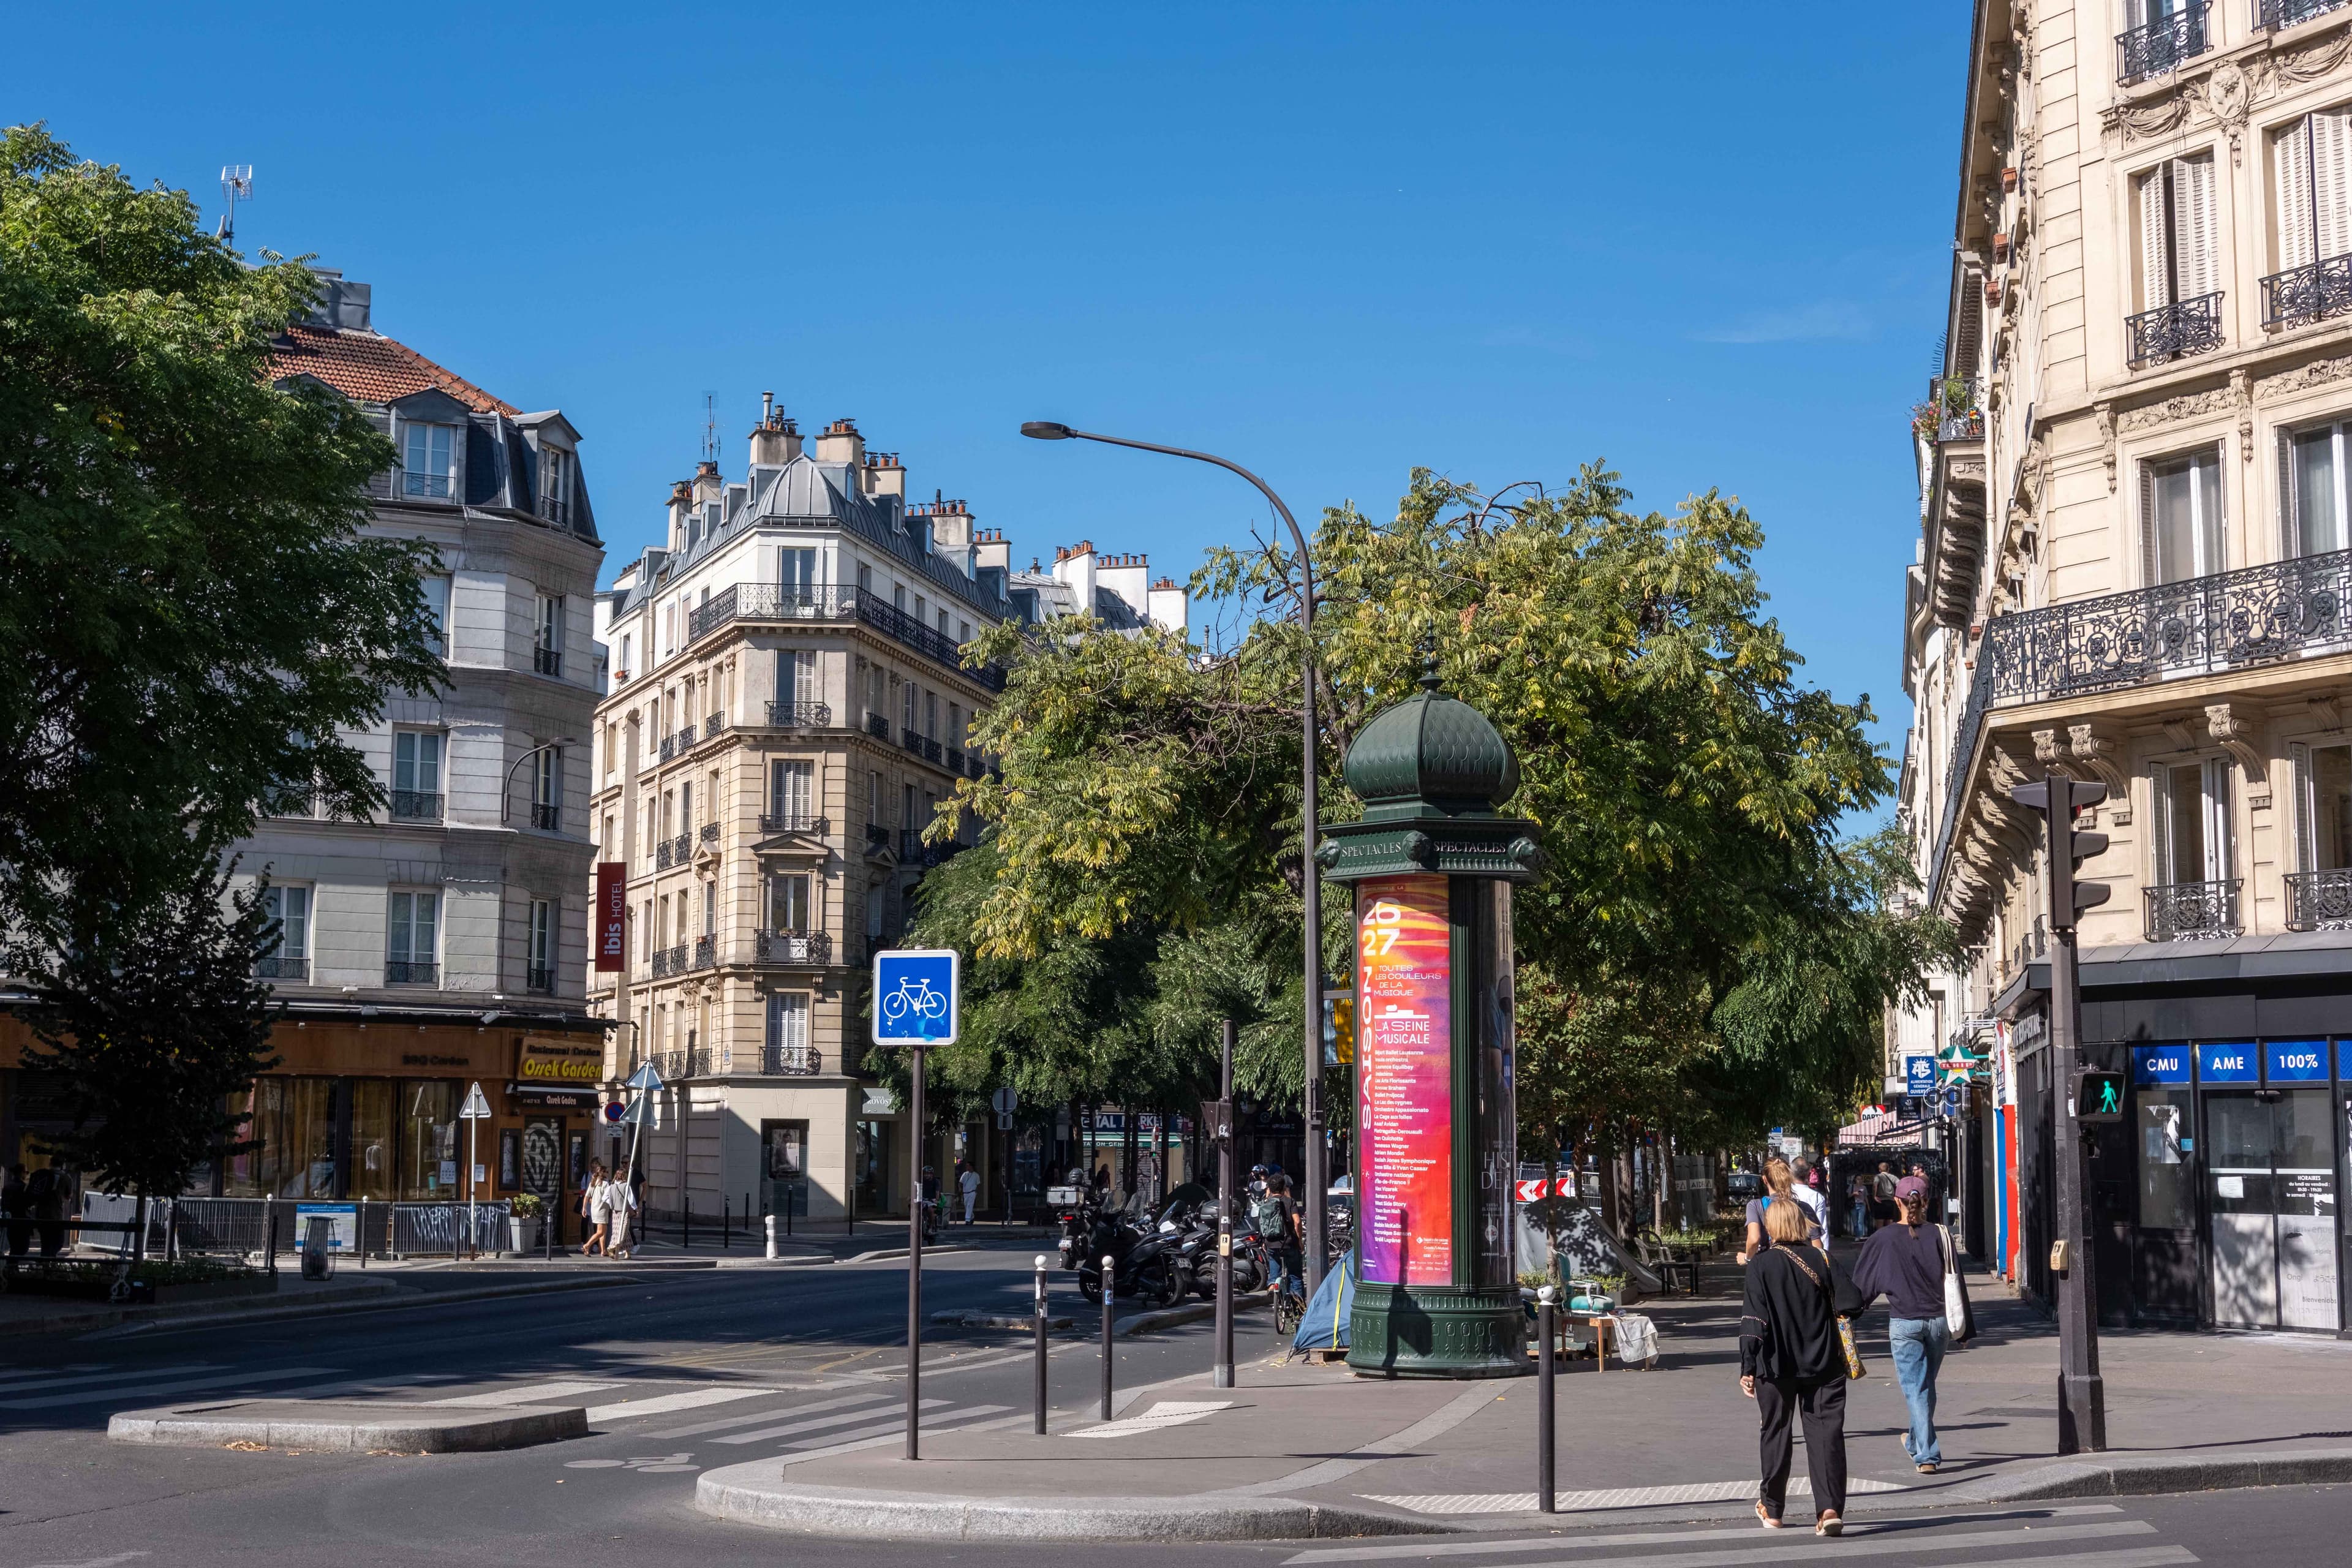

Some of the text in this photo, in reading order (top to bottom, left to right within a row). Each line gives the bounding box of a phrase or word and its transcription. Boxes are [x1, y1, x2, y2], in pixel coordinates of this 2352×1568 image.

[1341, 842, 1401, 858] SPECTACLES
[1433, 841, 1506, 854] SPECTACLES
[604, 880, 622, 954] ibis HOTEL
[1362, 897, 1401, 926] 26
[1362, 928, 1401, 956] 27
[1391, 1020, 1430, 1031] SEINE
[1374, 1033, 1430, 1044] MUSICALE
[1362, 966, 1373, 1130] SAISON
[525, 1058, 602, 1079] Ossek Garden
[2147, 1058, 2178, 1071] CMU
[2213, 1057, 2244, 1070] AME
[2279, 1054, 2318, 1069] 100%
[1912, 1063, 1931, 1079] AS
[1484, 1151, 1515, 1170] HIST
[2313, 1275, 2337, 1283] ようこそ
